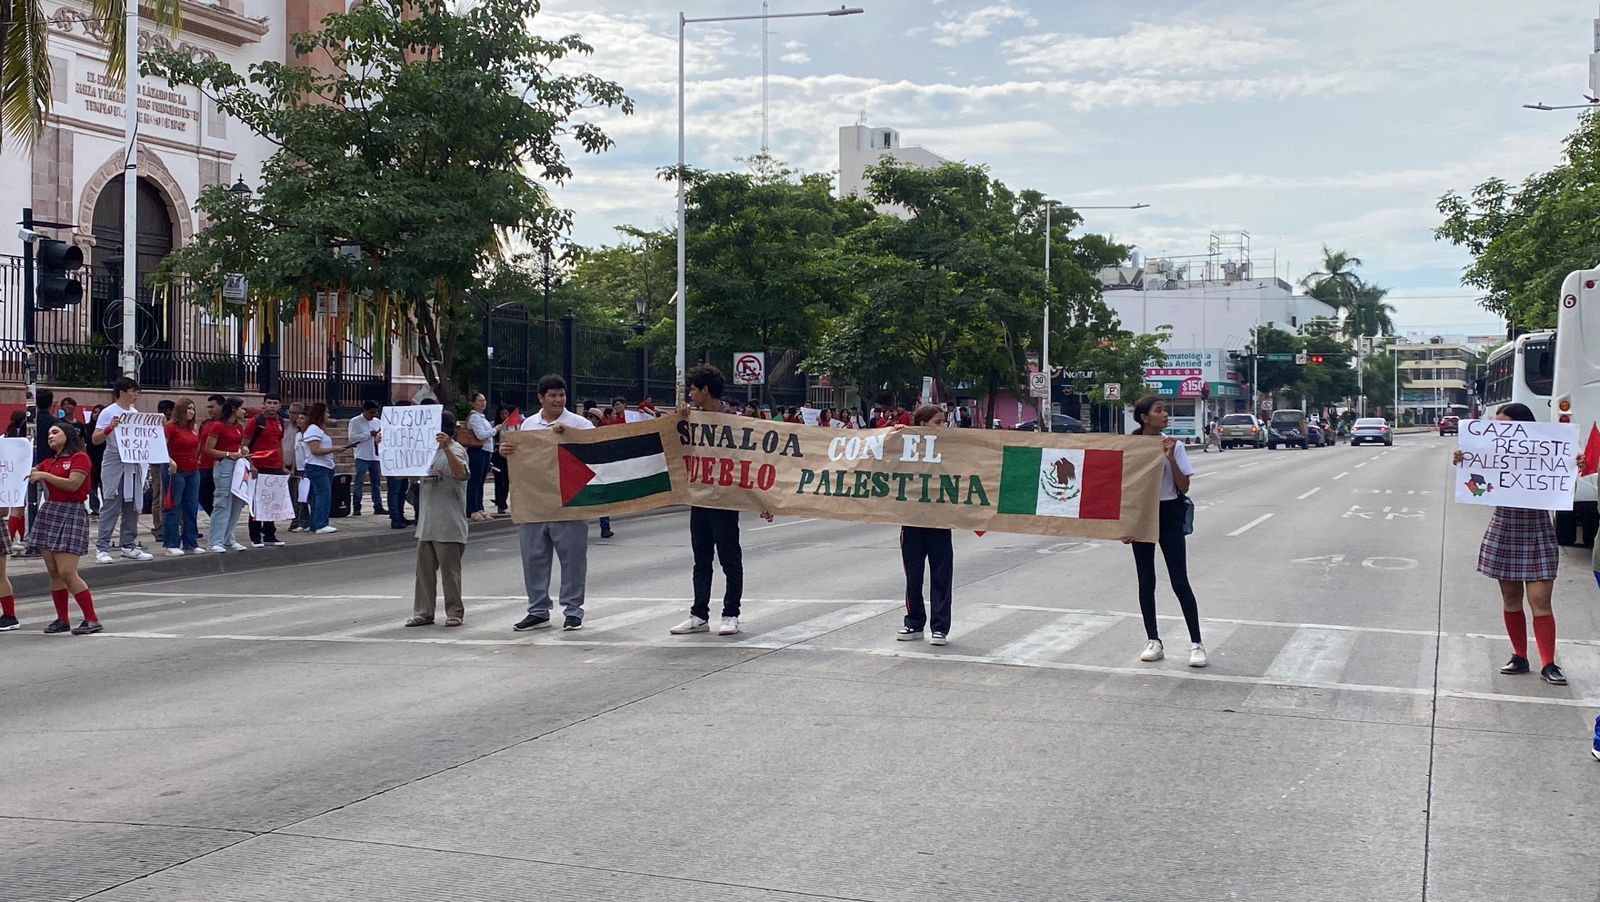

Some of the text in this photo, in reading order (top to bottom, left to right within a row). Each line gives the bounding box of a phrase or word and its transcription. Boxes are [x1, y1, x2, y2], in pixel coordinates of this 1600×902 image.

[1565, 295, 1574, 307] 6
[1034, 376, 1044, 384] 30
[382, 407, 400, 426] NO
[1467, 420, 1528, 438] GAZA
[676, 420, 942, 463] SINALOA CON EL
[1491, 437, 1571, 457] RESISTE
[1460, 451, 1569, 473] PALESTINA
[796, 469, 991, 506] PALESTINA
[1499, 471, 1571, 492] EXISTE
